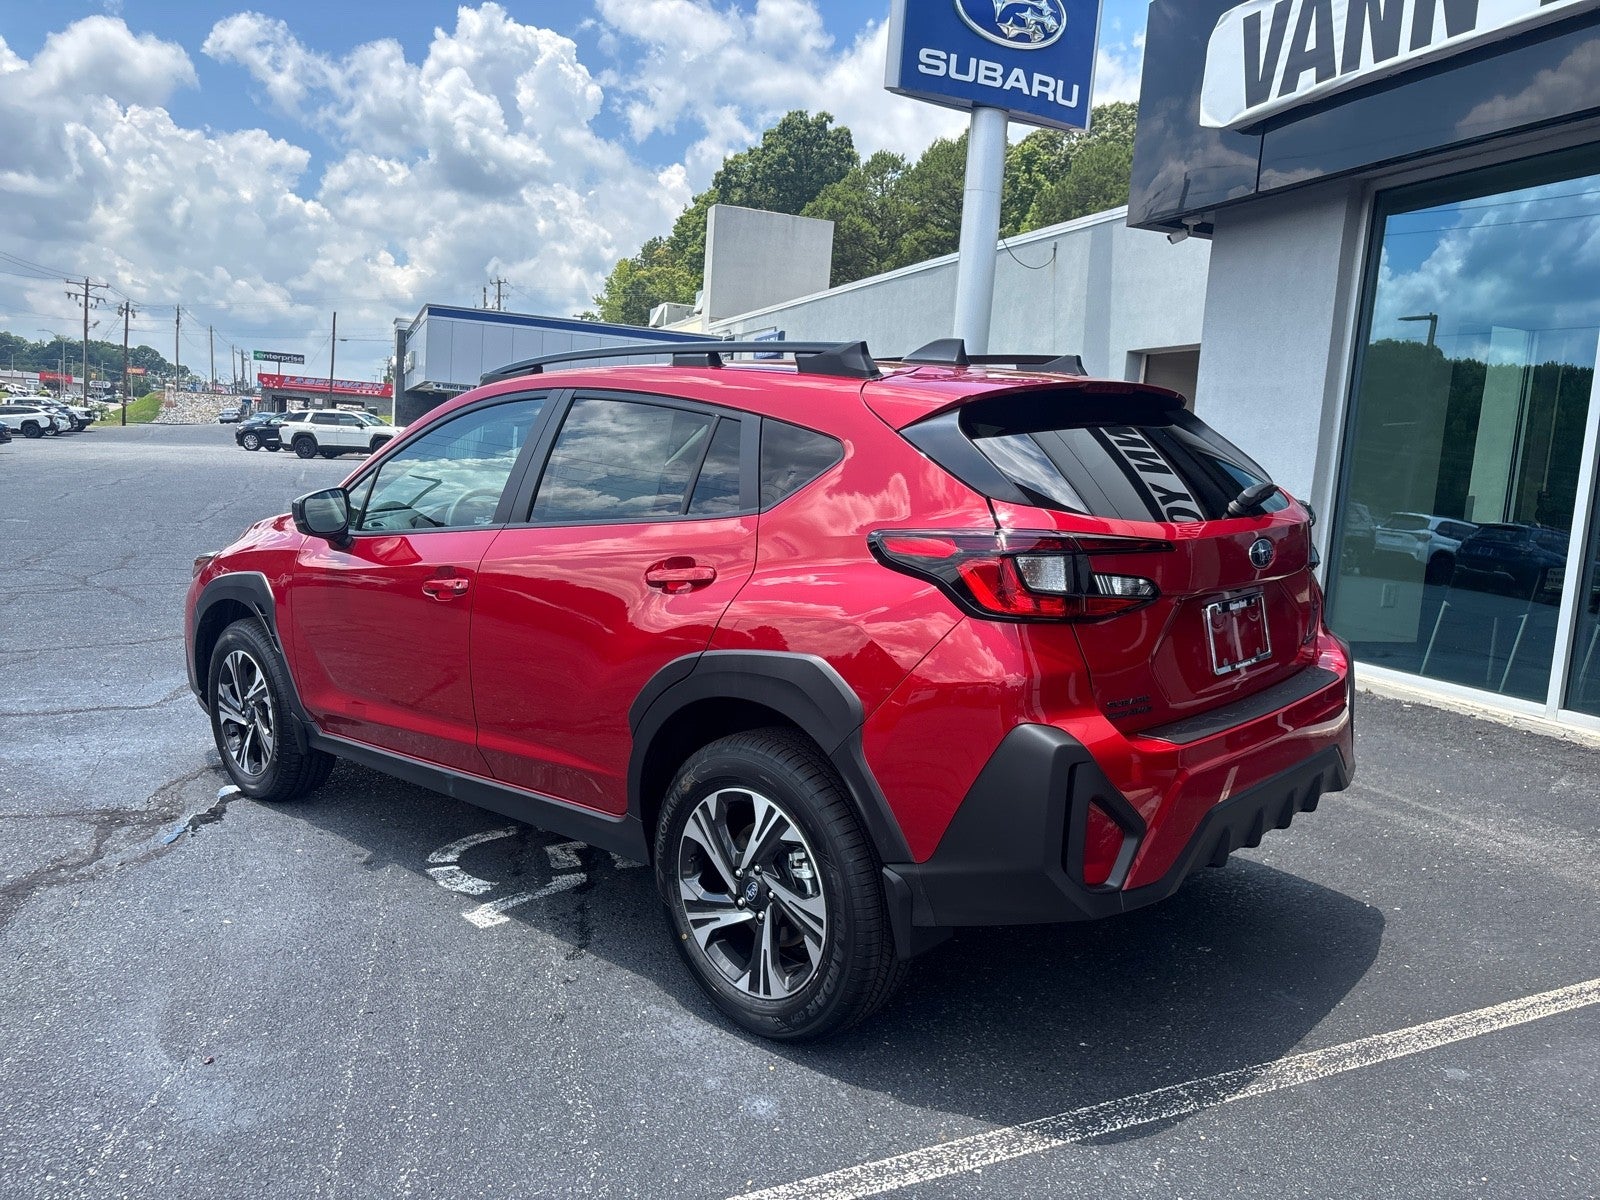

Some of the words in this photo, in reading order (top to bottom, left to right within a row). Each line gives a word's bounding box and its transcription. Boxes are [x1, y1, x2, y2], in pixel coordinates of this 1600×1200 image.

[918, 48, 1079, 108] SUBARU
[256, 352, 304, 362] enterprise
[656, 782, 684, 861] YOKOHAMA
